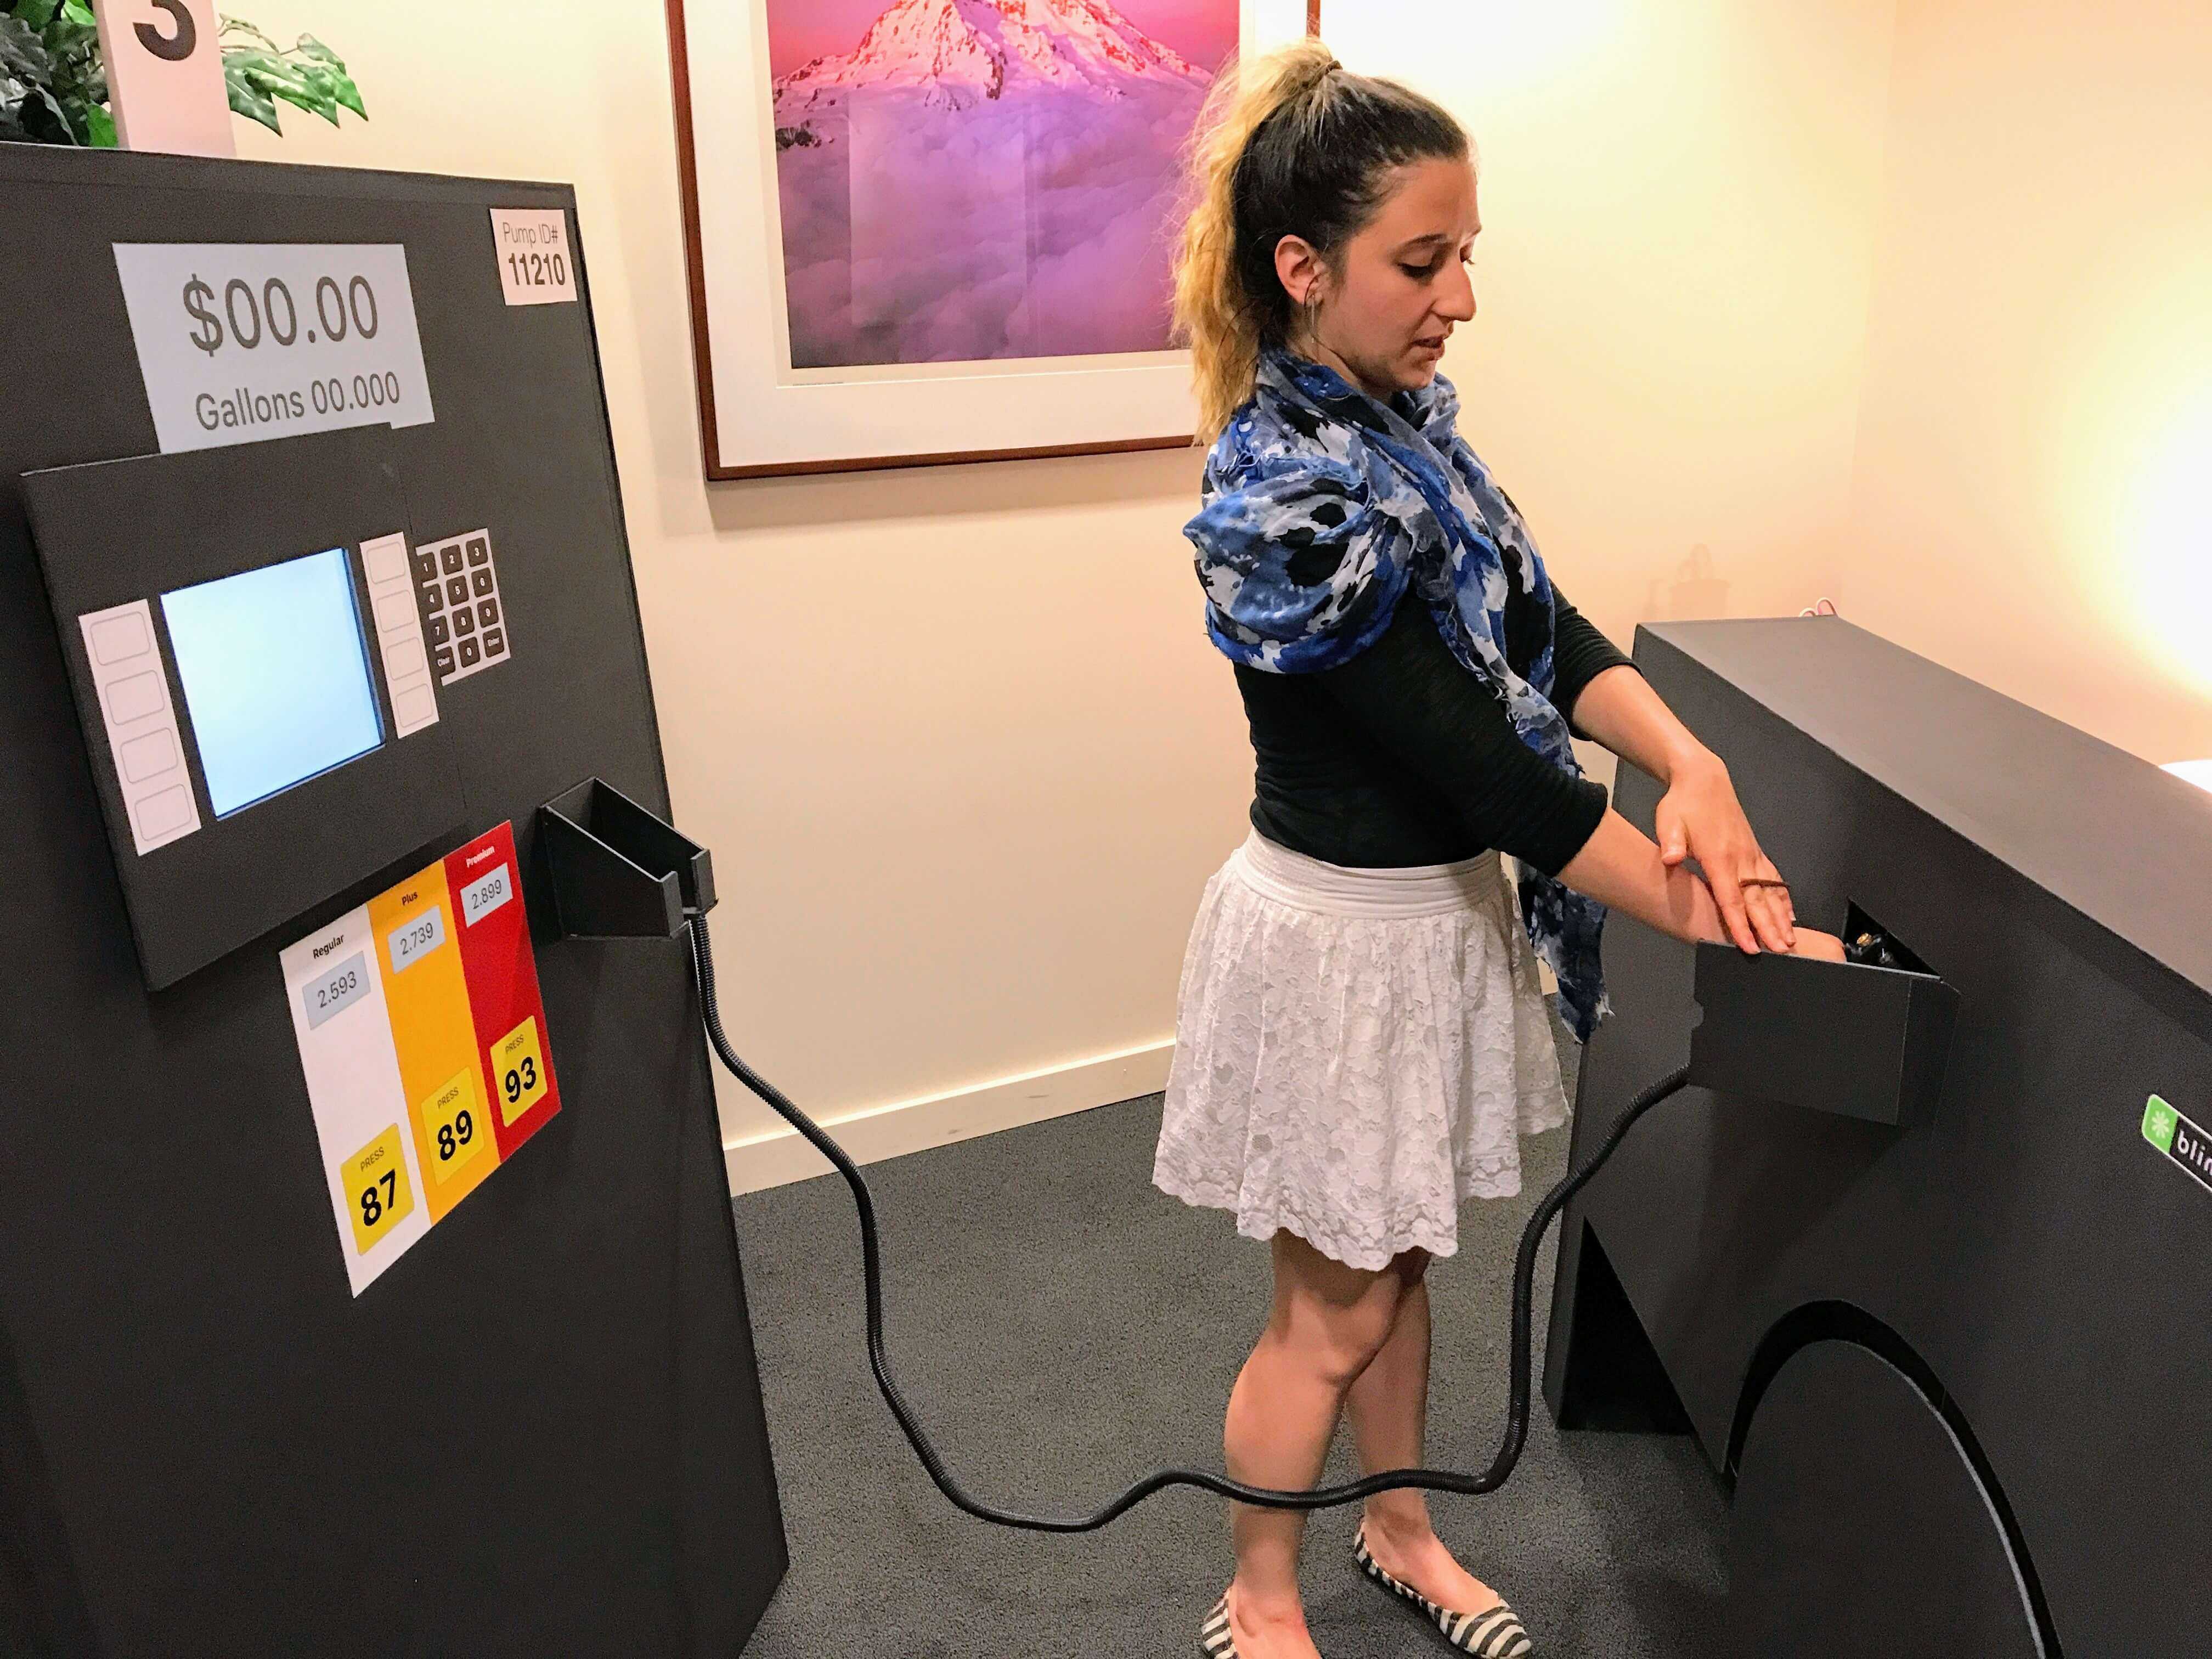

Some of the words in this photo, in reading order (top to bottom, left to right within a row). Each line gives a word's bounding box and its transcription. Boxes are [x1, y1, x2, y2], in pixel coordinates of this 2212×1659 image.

[503, 222, 536, 248] Pump
[538, 223, 558, 244] ID#
[509, 252, 565, 285] 11210
[183, 273, 378, 357] $00.00
[196, 387, 305, 430] Gallons
[311, 371, 400, 414] 00.000
[424, 563, 429, 572] 1
[449, 555, 455, 565] 2
[474, 547, 480, 557] 3
[429, 594, 435, 603] 4
[455, 585, 461, 595] 5
[480, 577, 486, 587] 6
[435, 626, 440, 635] 7
[461, 616, 467, 627] 8
[486, 607, 491, 618] 9
[467, 647, 472, 657] 0
[466, 846, 495, 867] Premium
[402, 891, 418, 906] Plus
[472, 879, 502, 910] 2.899
[313, 934, 345, 959] Regular
[400, 922, 433, 956] 2.739
[318, 971, 357, 1008] 2.593
[505, 1034, 524, 1054] PRESS
[505, 1057, 537, 1103] 93
[437, 1087, 459, 1109] PRESS
[438, 1110, 473, 1161] 89
[360, 1146, 385, 1172] PRESS
[361, 1169, 396, 1226] 87
